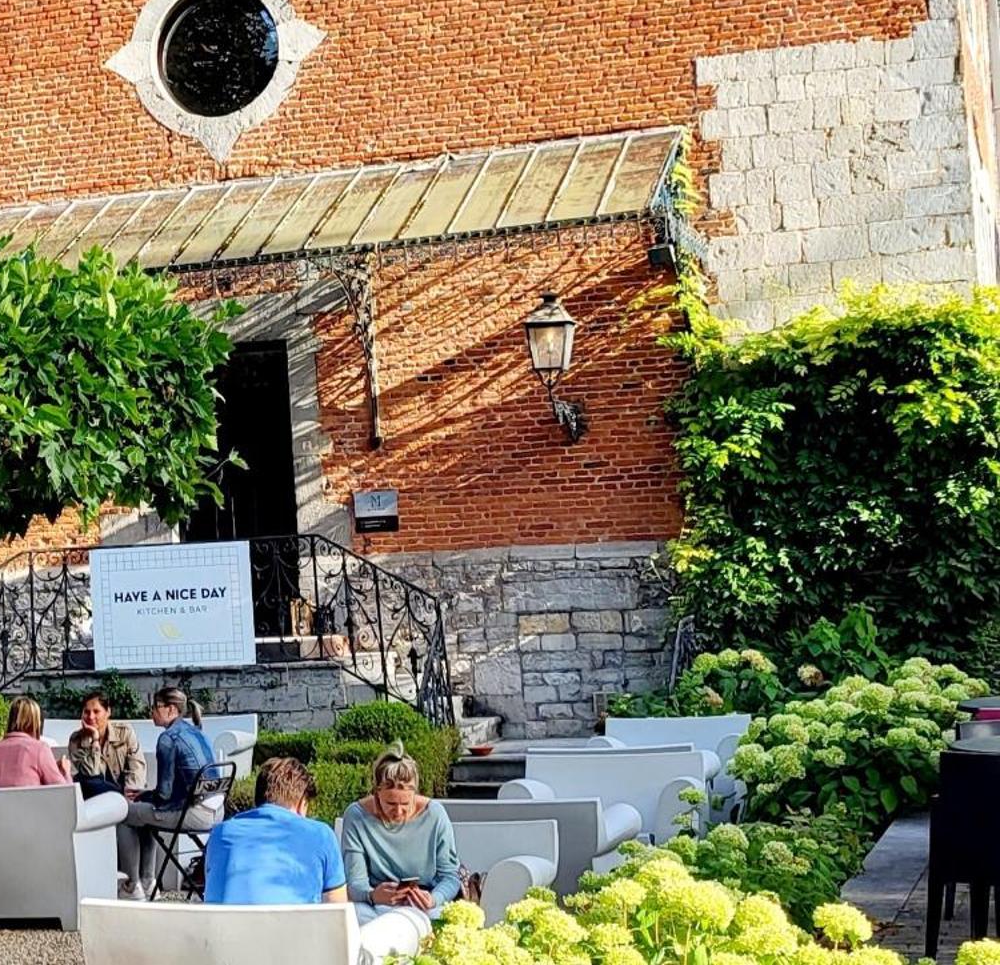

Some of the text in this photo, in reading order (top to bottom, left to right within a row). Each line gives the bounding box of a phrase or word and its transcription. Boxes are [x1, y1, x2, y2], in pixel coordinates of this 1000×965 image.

[114, 586, 227, 603] HAVE A NICE DAY
[136, 607, 177, 615] KITCHEN
[189, 605, 208, 614] BAR
